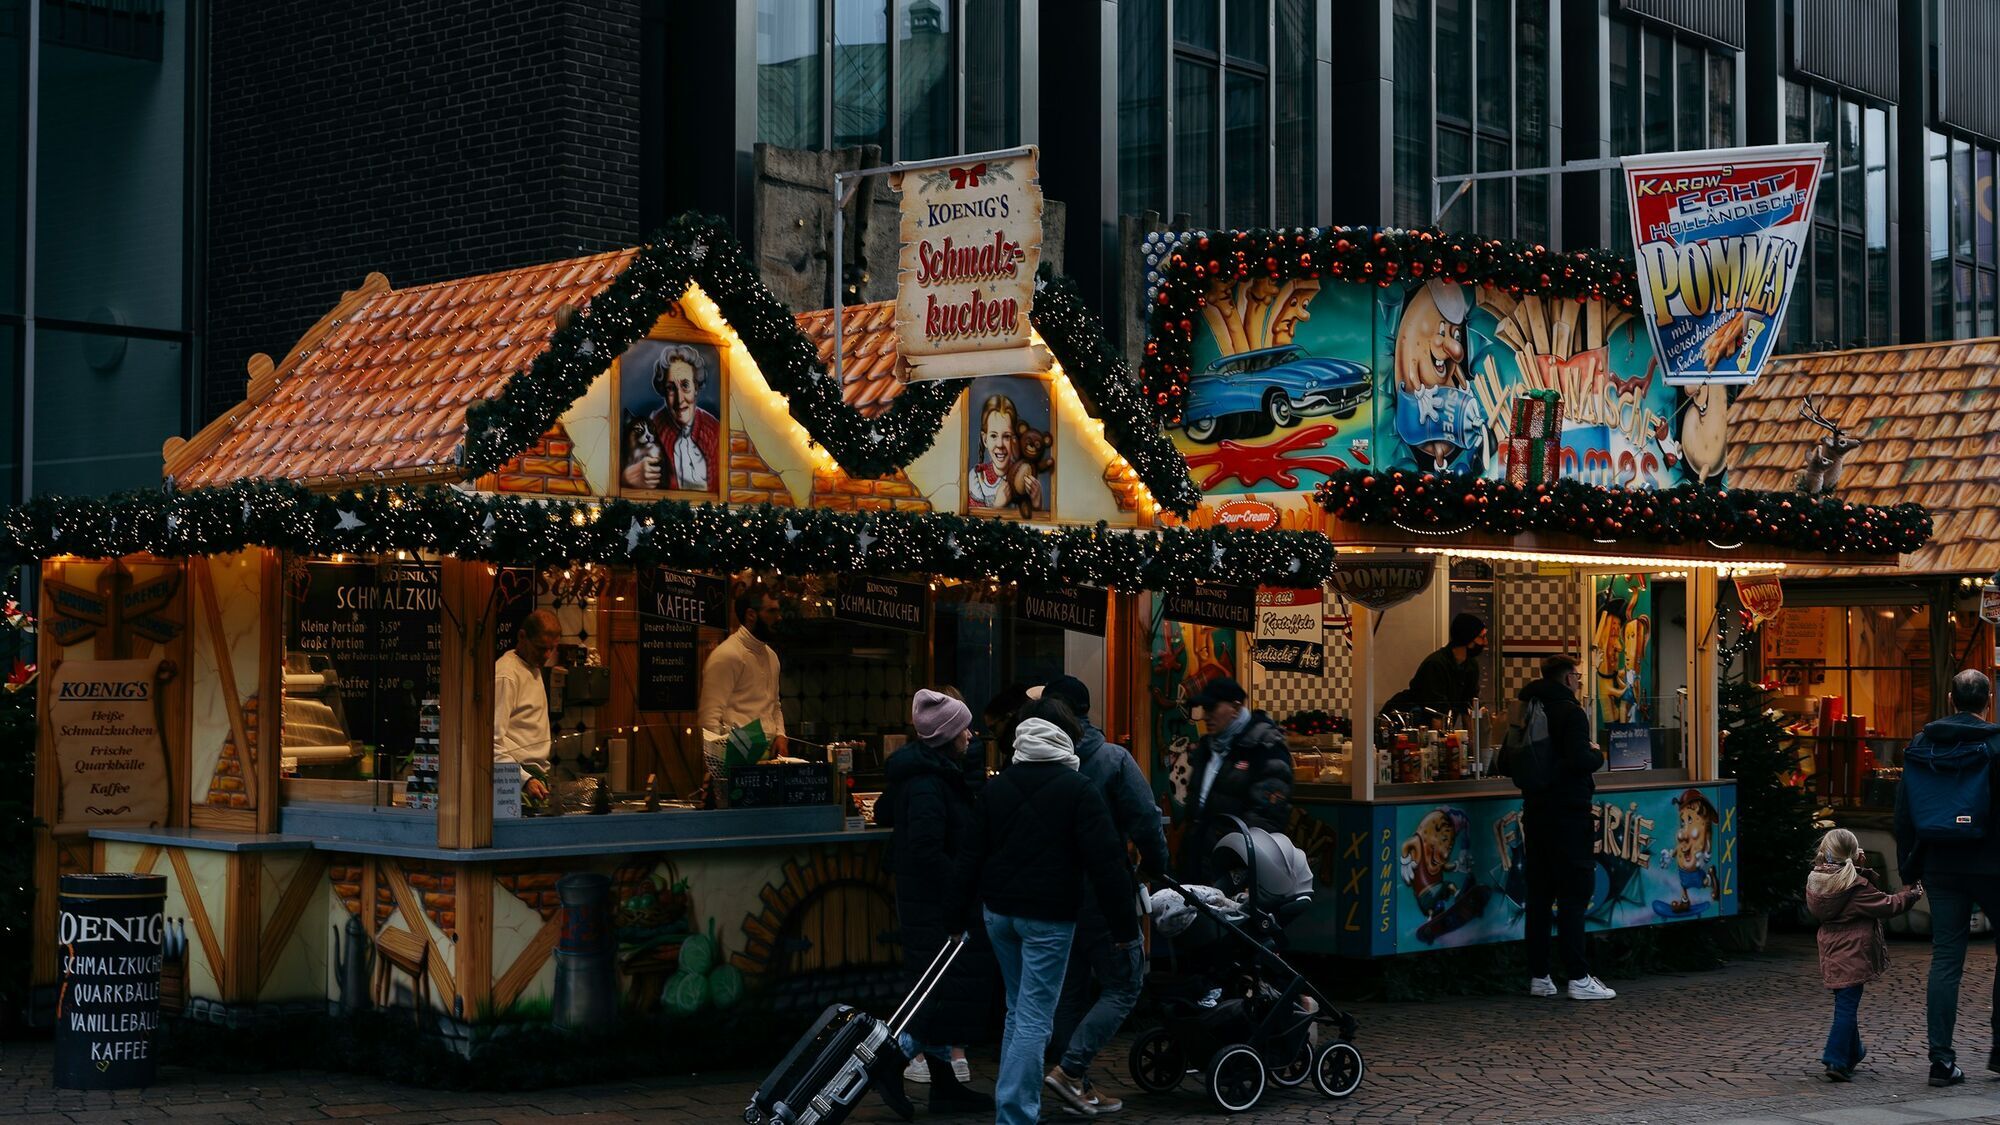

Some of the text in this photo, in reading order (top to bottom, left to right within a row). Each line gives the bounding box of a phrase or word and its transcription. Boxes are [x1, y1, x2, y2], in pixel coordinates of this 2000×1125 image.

[1677, 175, 1784, 216] ECHT
[927, 194, 1009, 227] KOENIG'S
[1651, 189, 1806, 241] HOLLÄNDISCHE
[917, 230, 1025, 287] Schmalz-
[1640, 235, 1797, 327] POMMES
[925, 288, 1018, 340] kuchen
[1671, 319, 1693, 340] mit
[1443, 389, 1458, 442] SUPER
[1220, 510, 1270, 524] Sour-Cream
[390, 569, 440, 584] OENIG'S
[664, 571, 697, 588] KOENIG'S
[1333, 568, 1424, 592] POMMES
[867, 581, 898, 597] KOENIG'S
[1742, 584, 1780, 606] POMMES
[657, 591, 706, 624] KAFFEE
[840, 593, 920, 623] SCHMALZKUCHEN
[1026, 596, 1096, 627] QUARKBÄLLE
[1169, 597, 1250, 622] SCHMALZKUCHEN
[301, 619, 330, 633] Kleine
[332, 619, 367, 633] Portion
[1262, 611, 1316, 636] Kartoffeln
[300, 636, 329, 651] Große
[331, 636, 364, 650] Portion
[1299, 643, 1321, 668] Art
[59, 680, 149, 698] KOENIG'S
[337, 675, 369, 689] Kaffee
[91, 710, 125, 723] Heiße
[60, 725, 153, 737] Schmalzkuchen
[90, 746, 133, 756] Frische
[74, 759, 145, 774] Quarkbälle
[90, 783, 131, 797] Kaffee
[736, 775, 761, 788] KAFFEE
[1720, 806, 1737, 896] XXL
[1343, 831, 1370, 933] XXL
[1380, 827, 1395, 934] POMMES
[59, 910, 163, 945] OENIG
[91, 1041, 151, 1061] KAFFEE
